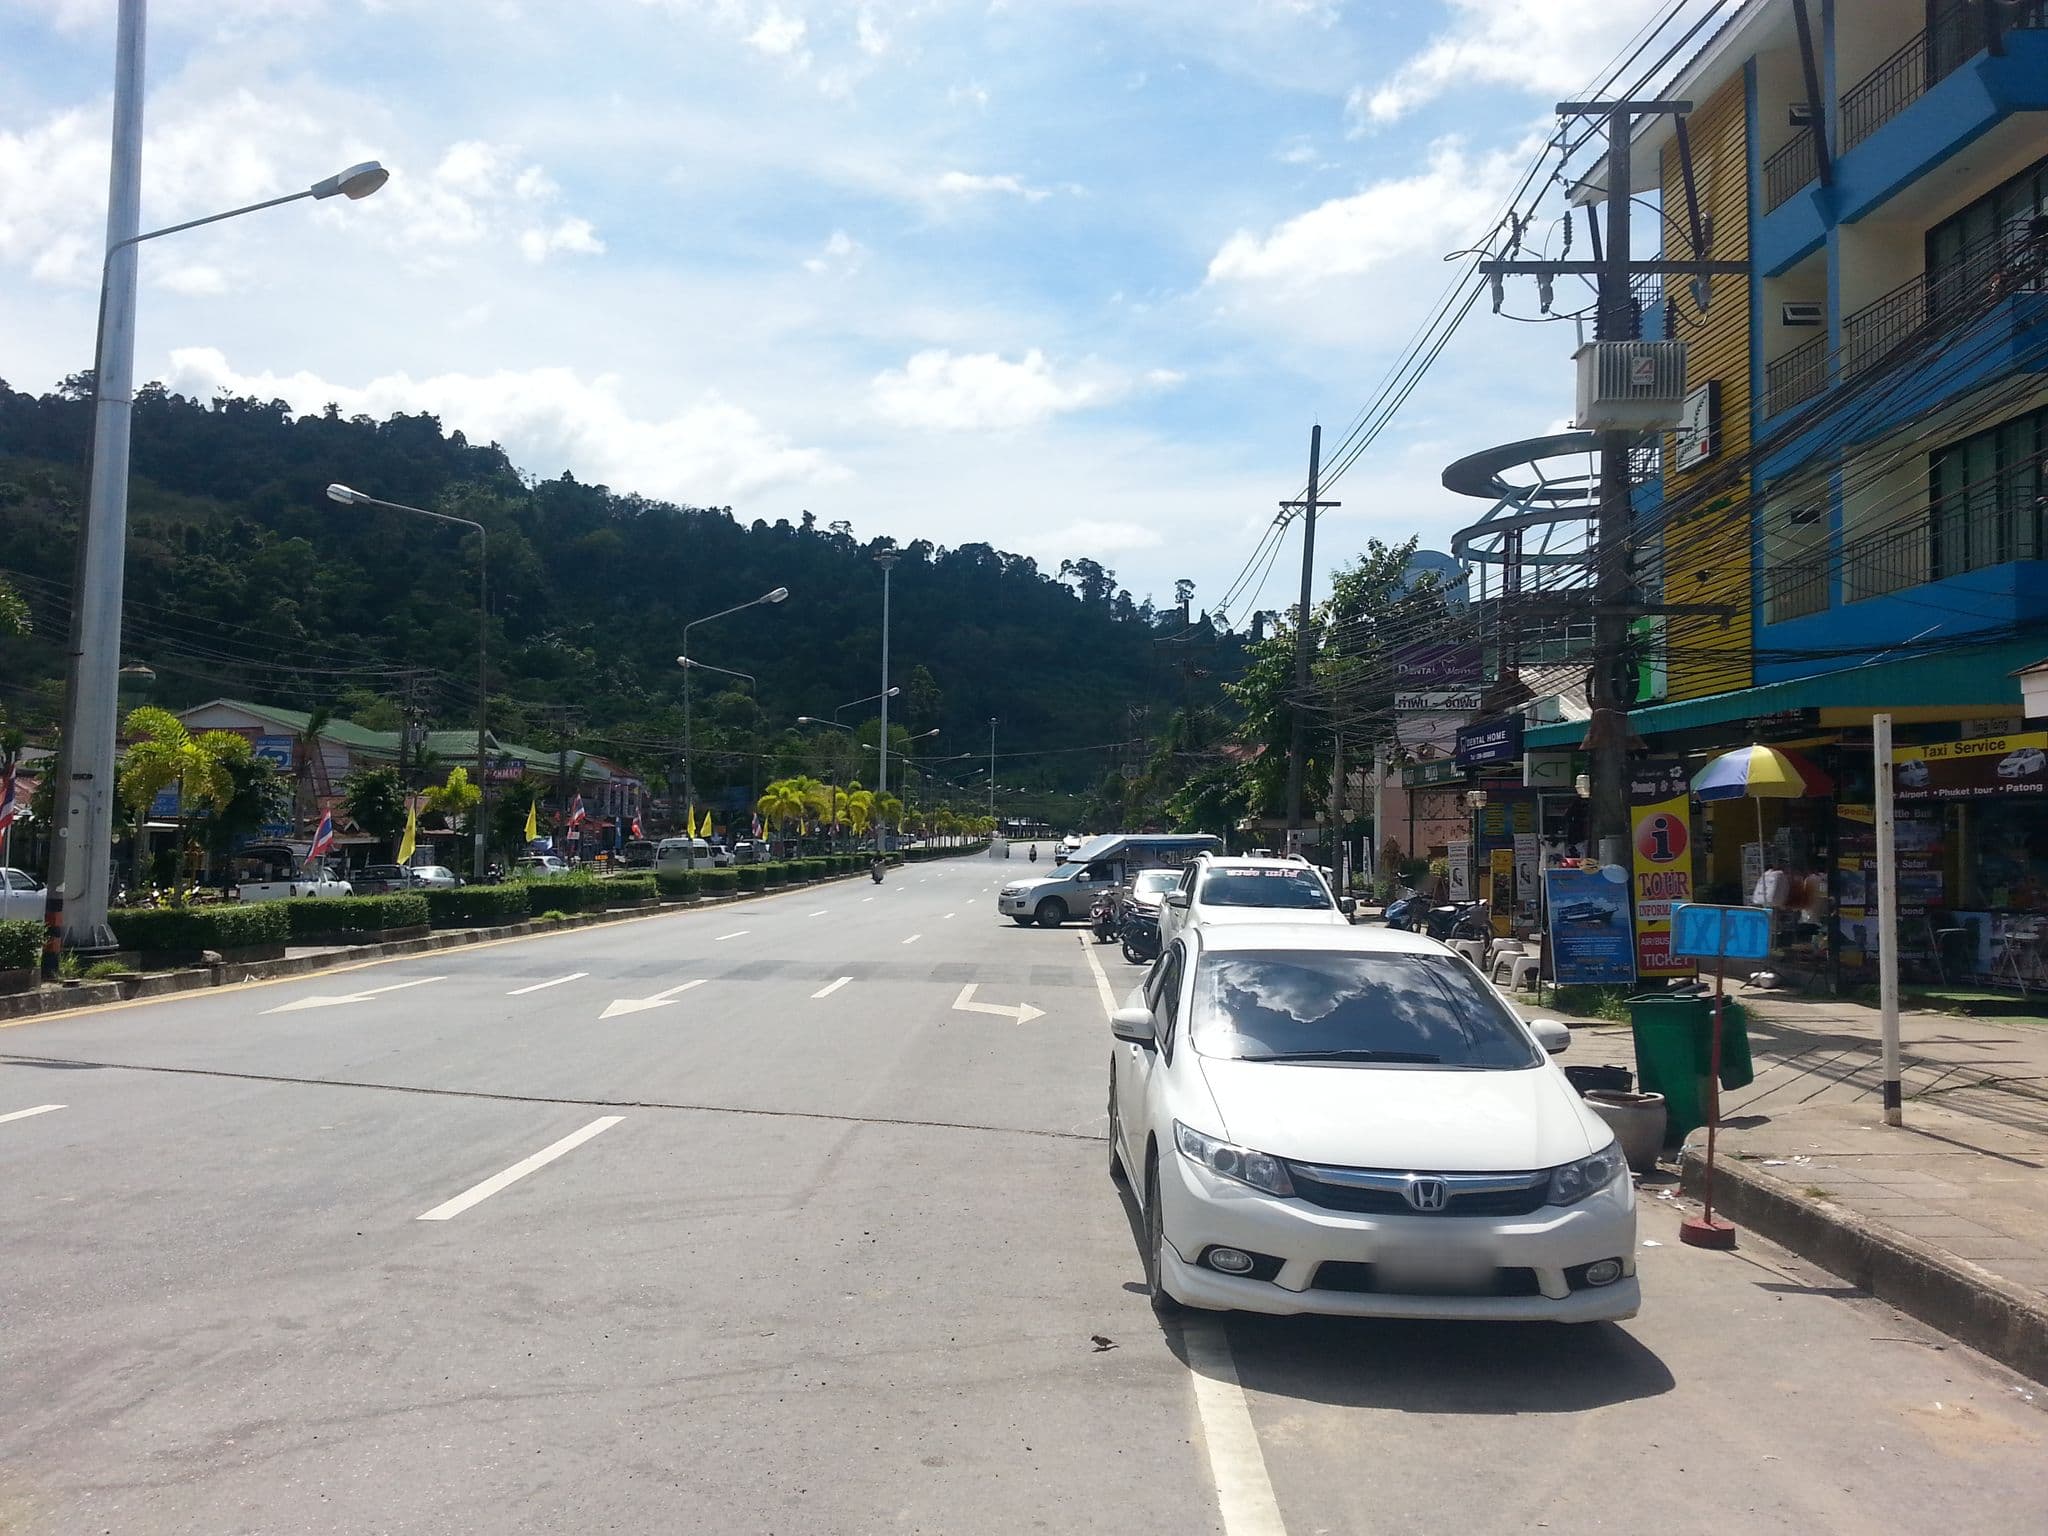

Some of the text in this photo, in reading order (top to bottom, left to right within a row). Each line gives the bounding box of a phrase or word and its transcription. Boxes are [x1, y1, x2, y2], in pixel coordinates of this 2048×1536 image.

[1466, 730, 1506, 747] DENTAL HOME
[1921, 739, 2006, 758] Taxi Service
[1531, 761, 1569, 778] KT
[1899, 783, 2043, 800] Airport Phuket tour Patong
[1639, 872, 1690, 897] TOUR
